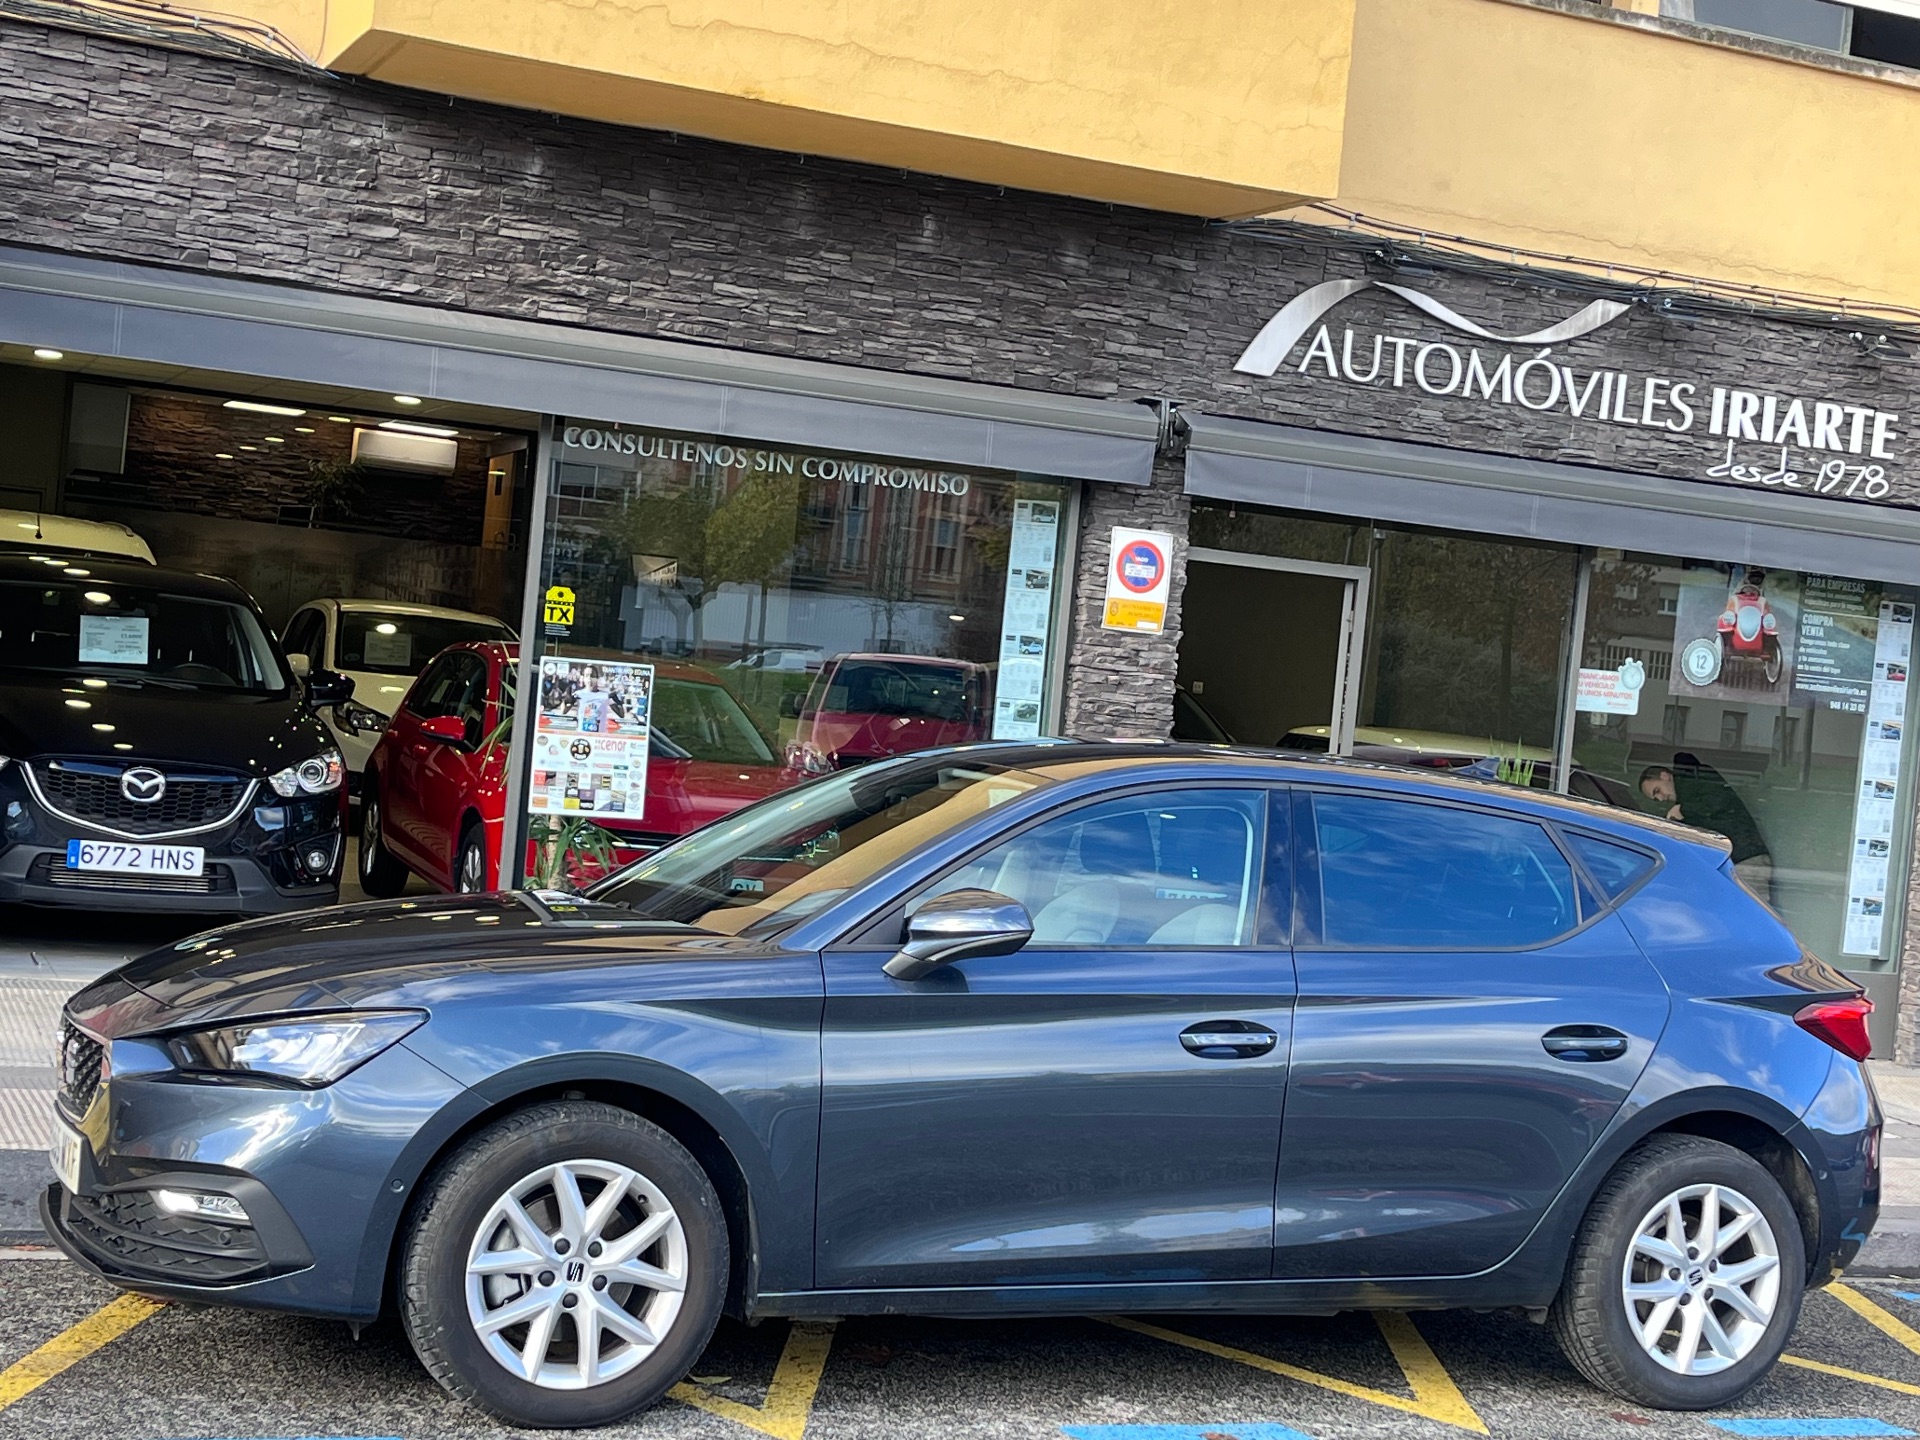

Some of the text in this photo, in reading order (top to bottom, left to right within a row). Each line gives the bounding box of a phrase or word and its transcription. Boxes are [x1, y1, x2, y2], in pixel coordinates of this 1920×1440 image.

[1296, 323, 1899, 460] AUTOMÓVILES IRIARTE
[562, 425, 969, 497] CONSULTENOS SIN COMPROMISO
[1705, 438, 1890, 499] desde 1978
[1806, 577, 1866, 593] PARA EMPRESAS
[547, 606, 571, 622] TX
[1802, 613, 1834, 627] COMPRA
[1801, 625, 1824, 637] VENTA
[1696, 654, 1708, 670] 12
[1578, 672, 1620, 682] INANCIAMOS
[1584, 681, 1616, 689] VEHÍCULO
[80, 844, 195, 870] 6772 HNS
